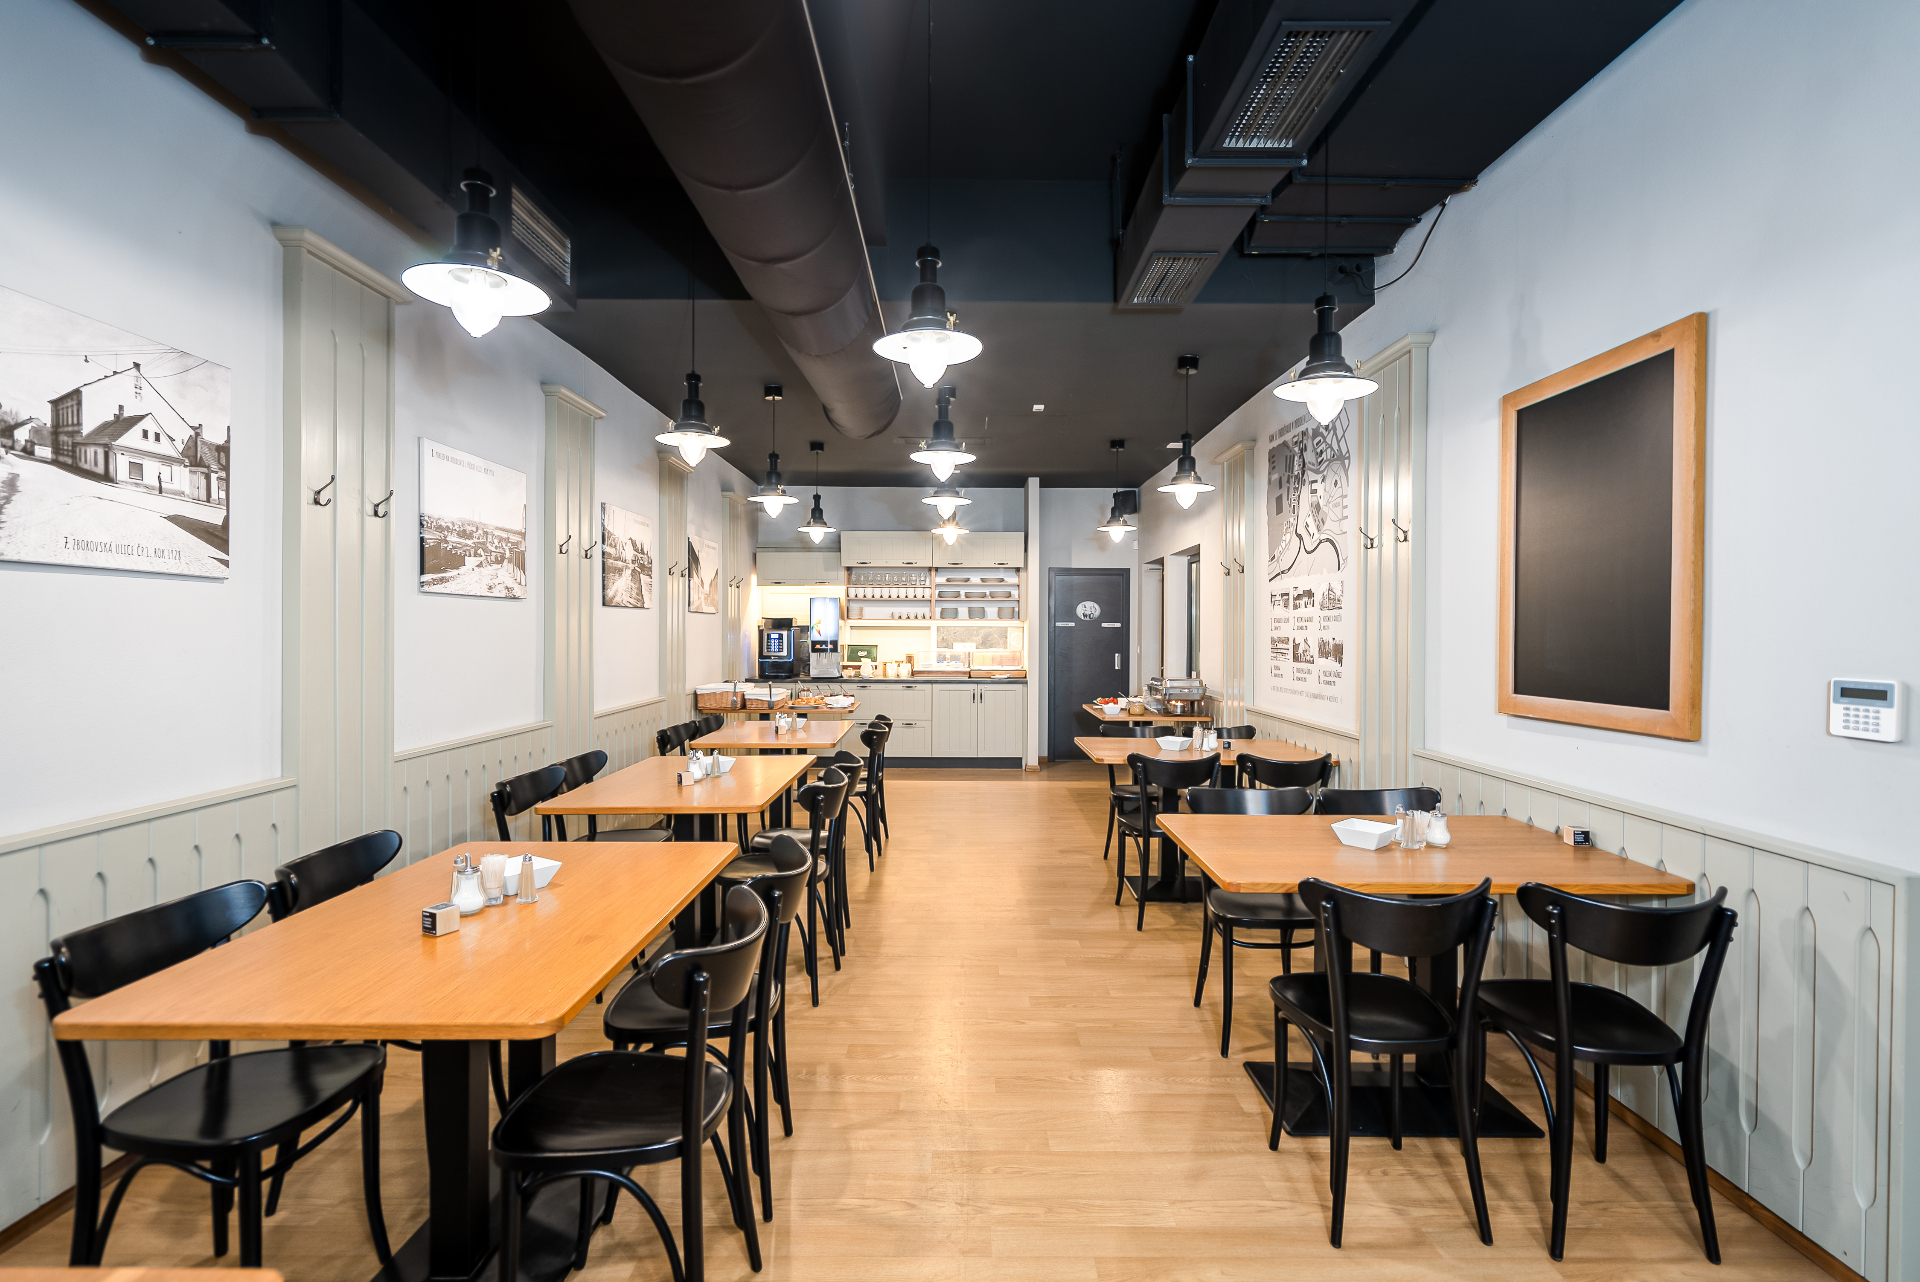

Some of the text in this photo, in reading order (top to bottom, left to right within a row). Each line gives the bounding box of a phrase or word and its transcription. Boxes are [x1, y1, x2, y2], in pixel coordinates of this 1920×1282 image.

[64, 536, 70, 549] 7.
[72, 538, 113, 554] ZBOROVSKÁ
[115, 543, 134, 556] ULICE
[153, 547, 166, 560] ROK
[167, 548, 182, 561] 1928
